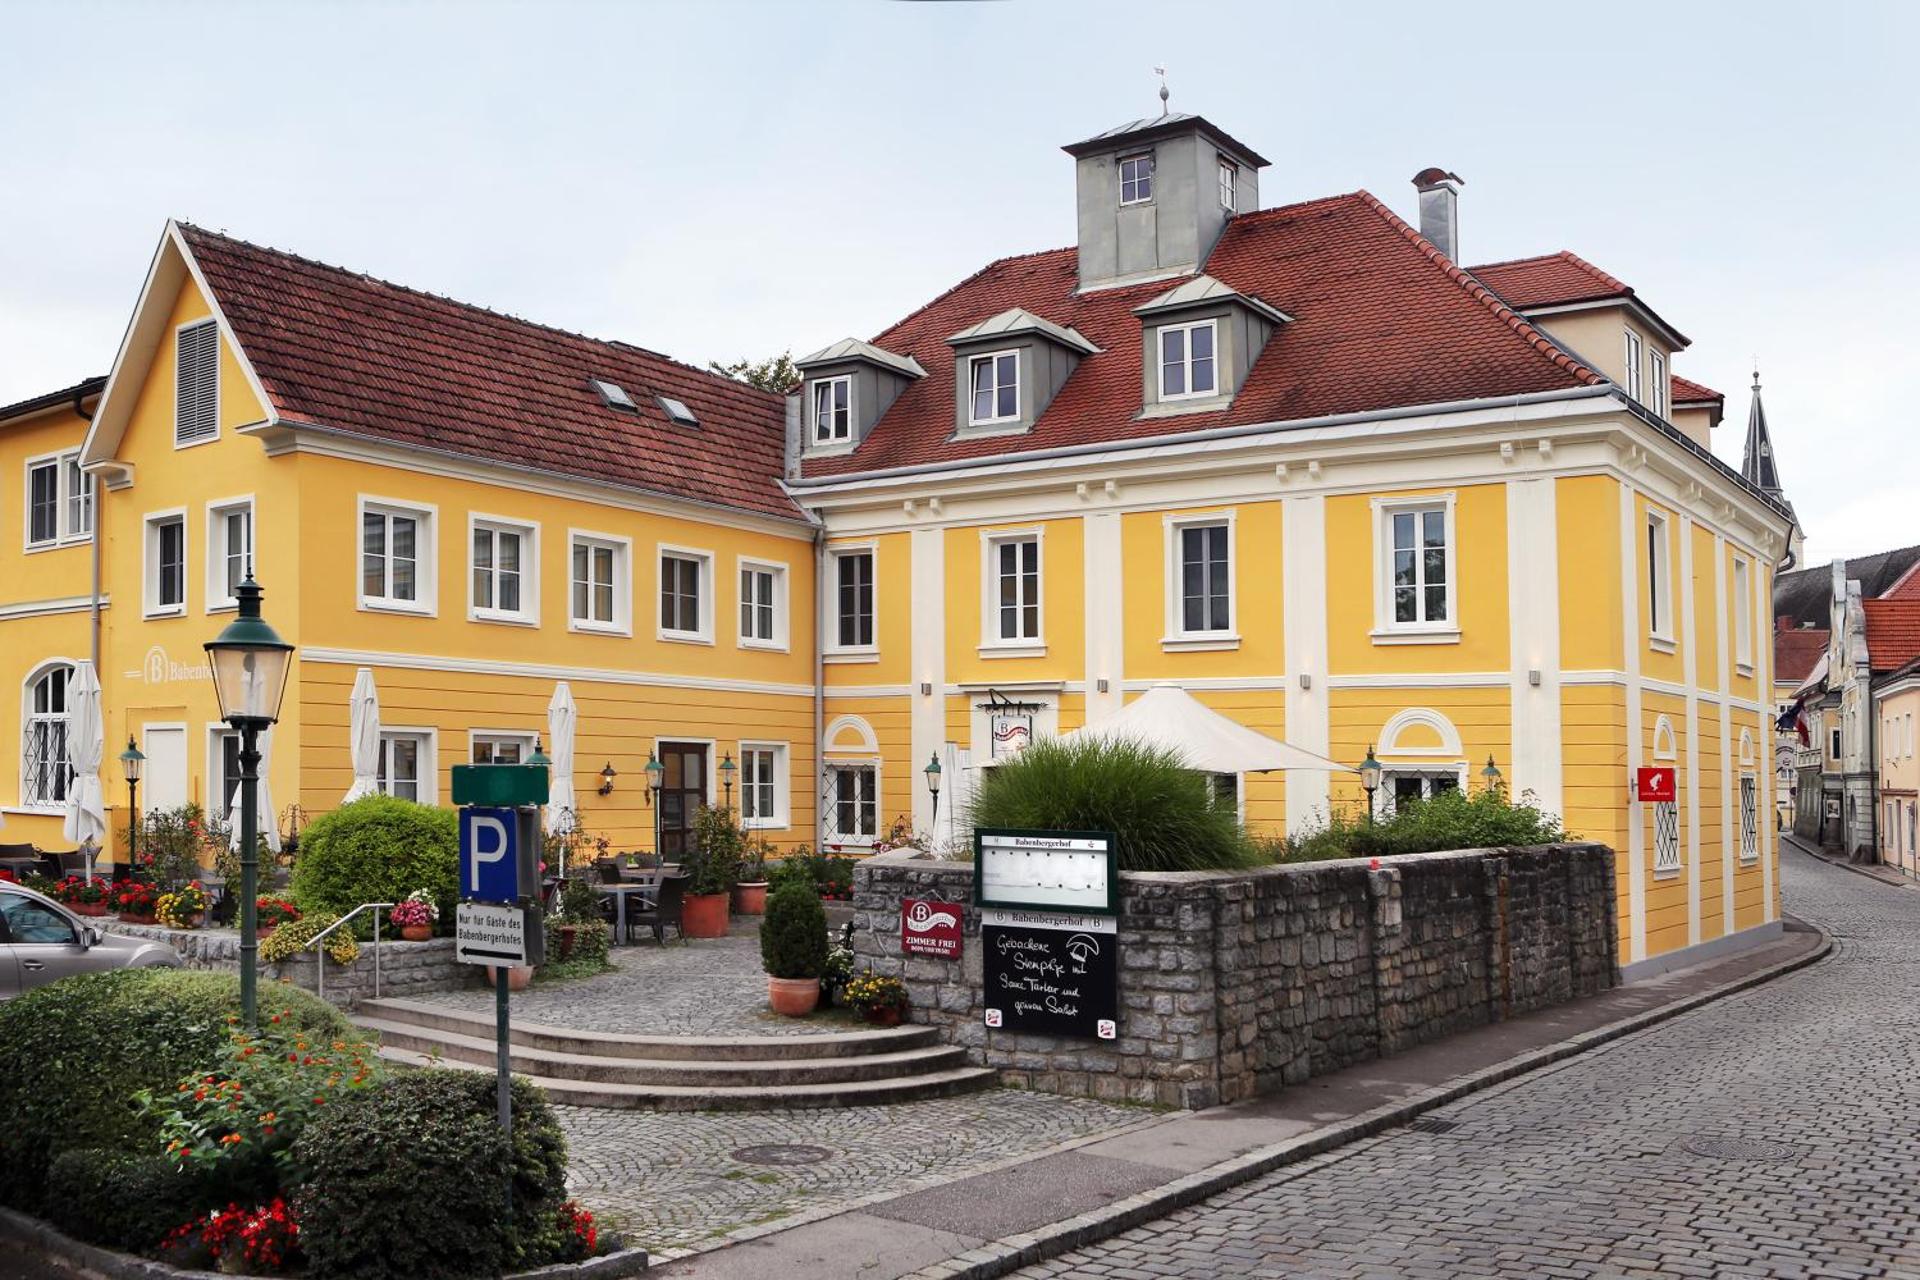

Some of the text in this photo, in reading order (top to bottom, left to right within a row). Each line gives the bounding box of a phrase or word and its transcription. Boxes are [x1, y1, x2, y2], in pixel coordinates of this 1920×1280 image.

[151, 655, 213, 684] B Babenbe
[1015, 838, 1072, 849] Babenbergerhof
[470, 816, 508, 892] P
[459, 913, 471, 925] Nur
[487, 915, 507, 928] Gäste
[508, 917, 521, 929] des
[916, 905, 928, 921] B
[1012, 913, 1083, 927] Babenbergerhof
[459, 928, 522, 945] Babenbergerhofes
[906, 936, 956, 948] ZIMMER FREI
[1061, 988, 1081, 998] und
[1045, 995, 1079, 1017] Salat
